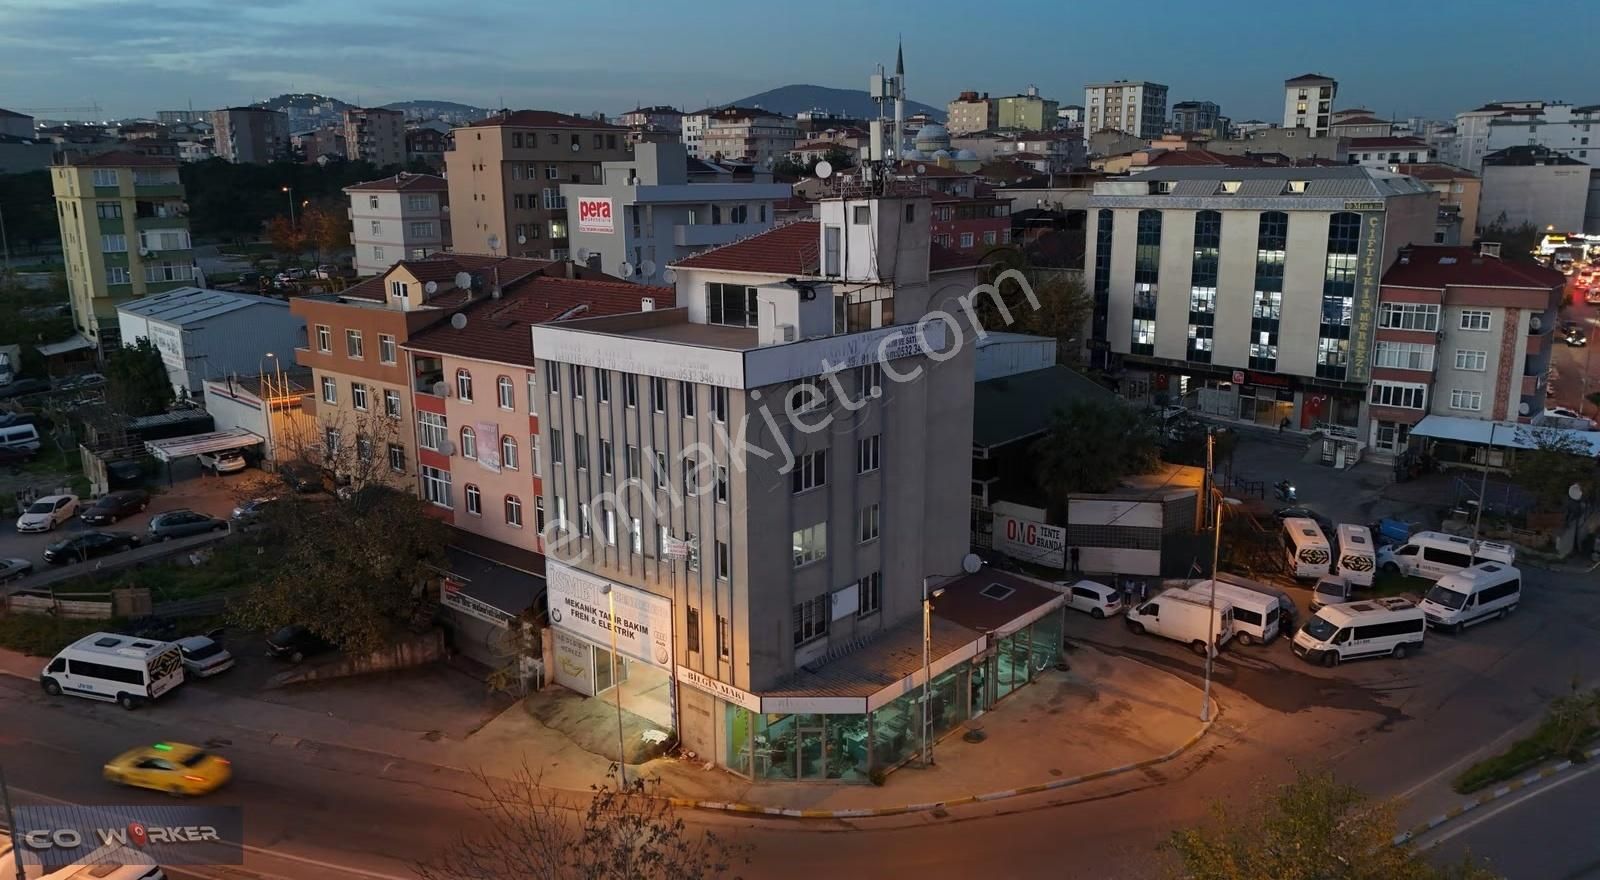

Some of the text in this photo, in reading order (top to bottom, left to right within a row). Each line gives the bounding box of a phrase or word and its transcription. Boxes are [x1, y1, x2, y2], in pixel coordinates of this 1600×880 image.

[580, 201, 611, 221] pera
[1007, 519, 1037, 546] OMG
[1041, 526, 1061, 540] TENTE
[1036, 537, 1063, 552] BRANDA
[564, 598, 598, 617] MEKANİK
[623, 619, 649, 635] BAKIM
[570, 609, 589, 622] FREN
[591, 616, 597, 625] &
